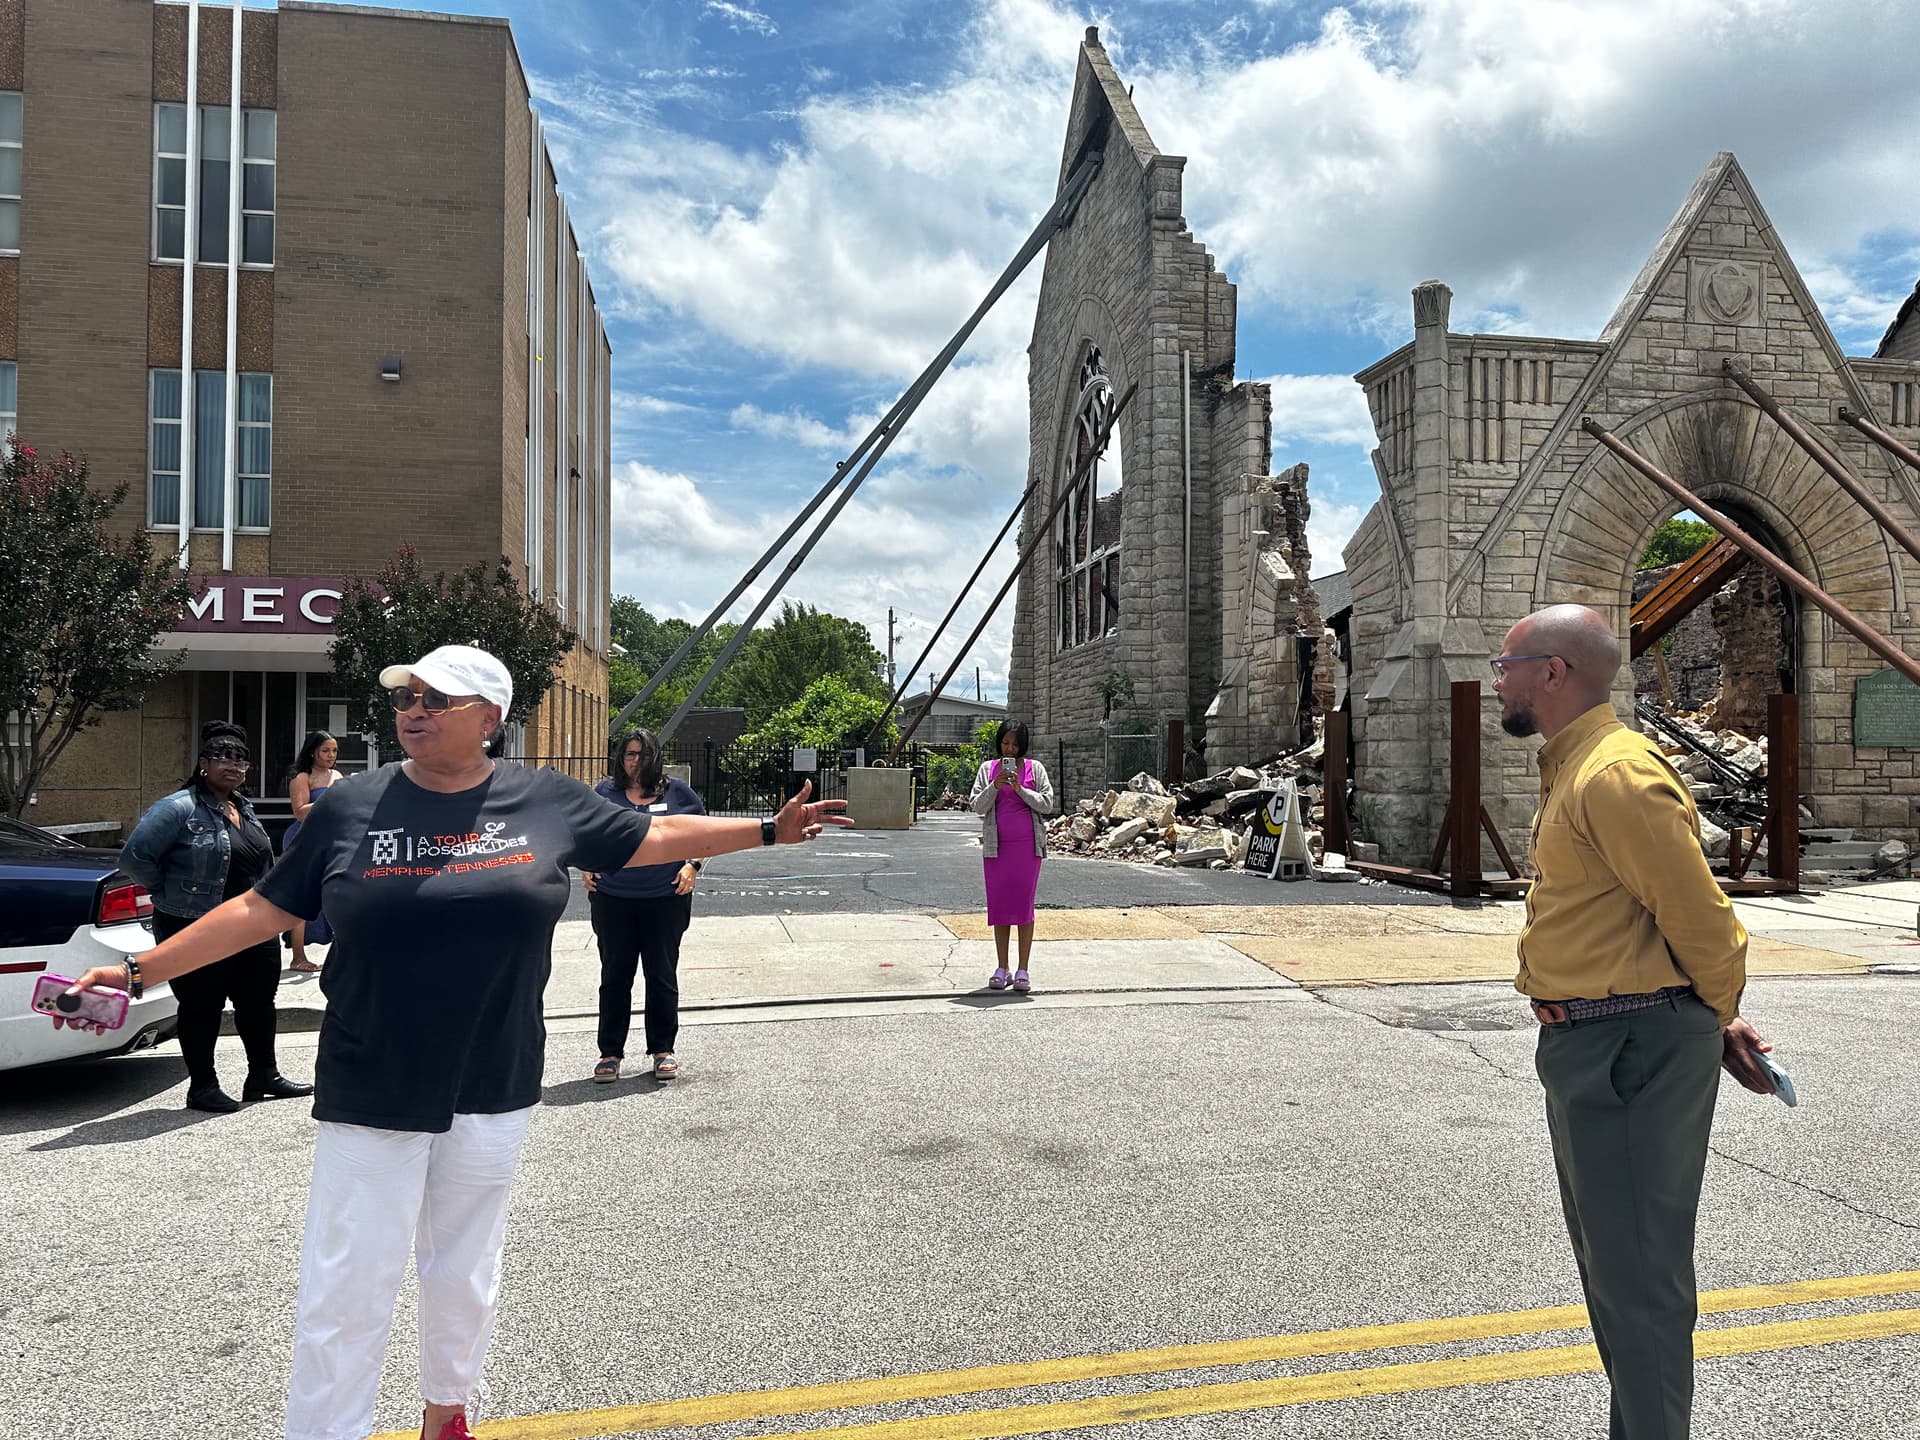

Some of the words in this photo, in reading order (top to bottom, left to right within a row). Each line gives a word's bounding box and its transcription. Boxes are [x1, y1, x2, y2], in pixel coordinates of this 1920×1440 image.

[1273, 796, 1284, 817] P
[417, 836, 430, 848] A
[433, 832, 482, 847] TOUR
[1251, 835, 1277, 854] PARK
[362, 866, 441, 879] MEMPHIS,
[443, 853, 535, 873] TENNESSEE
[1247, 852, 1269, 867] HERE
